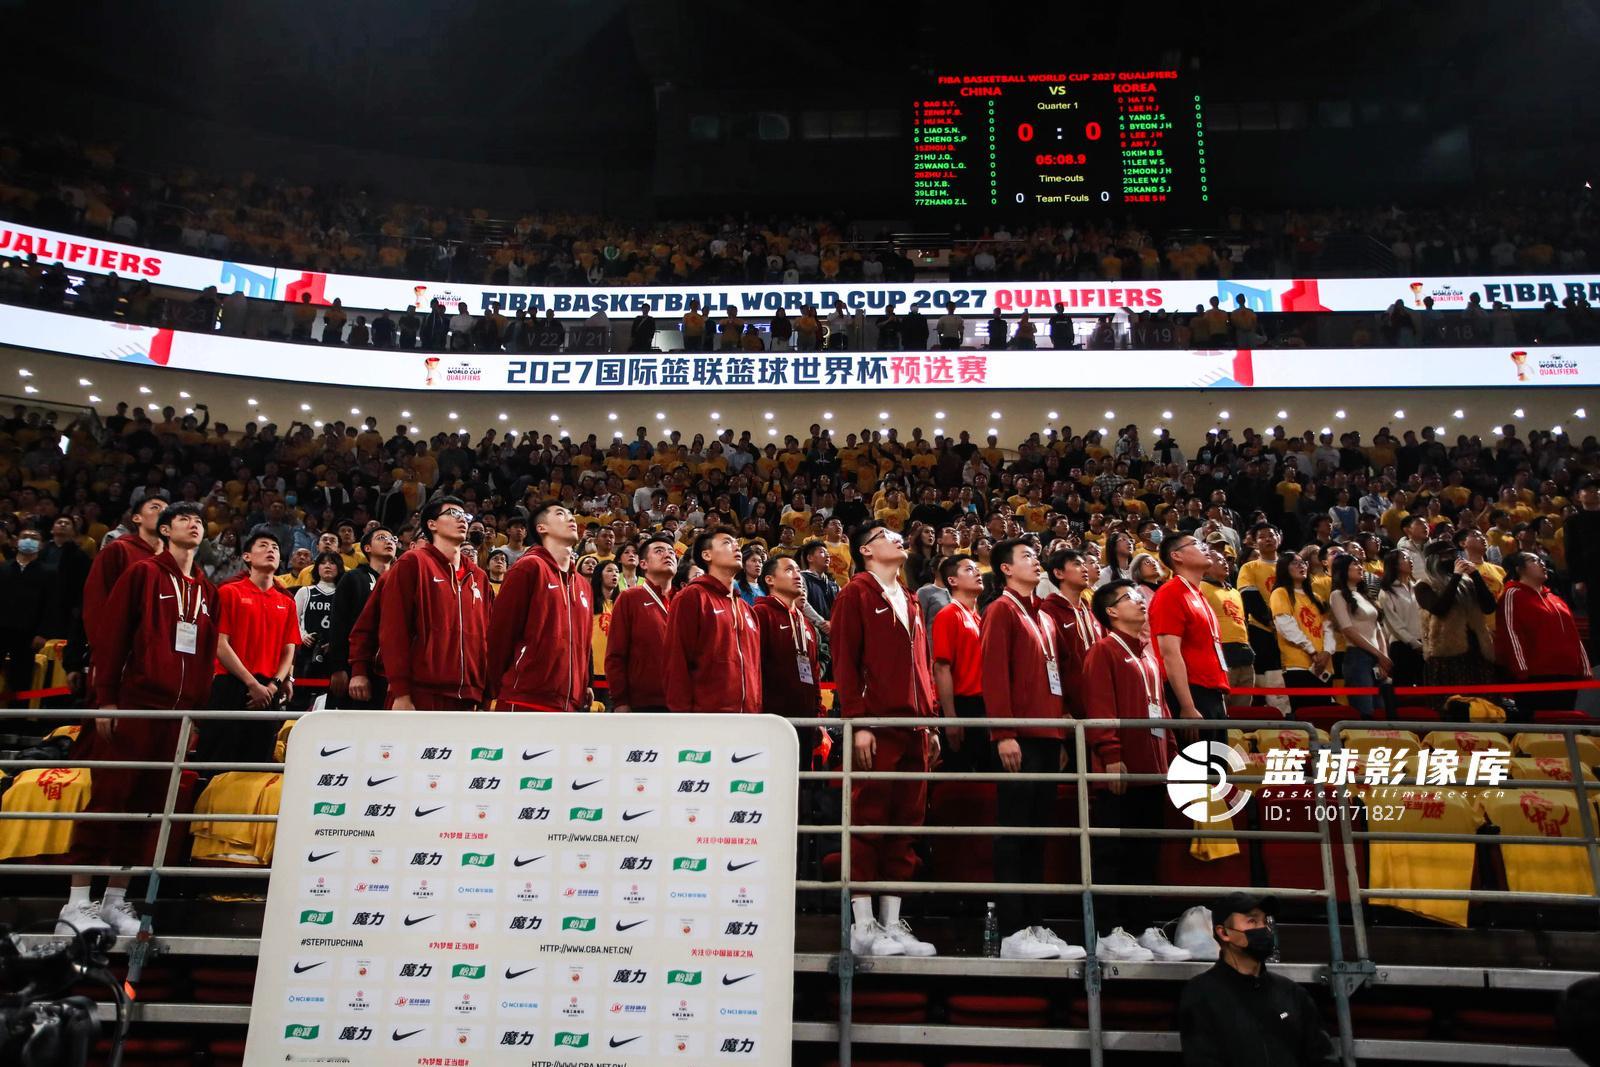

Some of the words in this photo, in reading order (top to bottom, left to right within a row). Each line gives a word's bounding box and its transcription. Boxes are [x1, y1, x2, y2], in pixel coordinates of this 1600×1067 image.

[938, 76, 961, 84] FIBA
[963, 75, 1026, 83] BASKETBALL
[1028, 74, 1067, 82] WORLD
[1118, 71, 1178, 80] QUALIFIERS
[960, 87, 1002, 97] CHINA
[1049, 86, 1066, 95] VS
[1113, 83, 1157, 93] KOREA
[1037, 102, 1071, 110] Quarter
[1018, 123, 1034, 142] 0
[1085, 122, 1101, 140] 0
[1035, 154, 1086, 165] 05:08.9
[1039, 174, 1084, 183] Time-outs
[1016, 193, 1024, 203] 0
[1036, 195, 1062, 203] Team
[1064, 194, 1089, 202] Fouls
[1101, 191, 1109, 201] 0
[1483, 283, 1558, 302] FIBA
[481, 292, 546, 311] FIBA
[553, 293, 730, 312] BASKETBALL
[741, 291, 839, 310] WORLD
[847, 290, 906, 309] CUP
[913, 290, 987, 308] 2027
[994, 288, 1163, 311] QUALIFIERS
[507, 355, 988, 386] 2027国际篮联篮球世界杯预选赛
[310, 601, 331, 611] KOR
[321, 615, 330, 629] 6
[421, 747, 452, 760] 魔力
[626, 749, 659, 763] 魔力
[317, 774, 349, 787] 魔力
[468, 776, 500, 790] 魔力
[677, 779, 710, 793] 魔力
[364, 803, 396, 817] 魔力
[518, 806, 550, 820] 魔力
[729, 810, 762, 824] 魔力
[314, 829, 375, 838] #STEPITUPCHINA
[547, 833, 639, 844] HTTP://WWW.CBA.NET.CN/
[410, 852, 442, 865] 魔力
[620, 856, 653, 870] 魔力
[352, 912, 384, 926] 魔力
[509, 916, 542, 930] 魔力
[724, 921, 759, 935] 魔力
[300, 938, 364, 948] #STEPITUPCHINA
[540, 944, 633, 956] HTTP://WWW.CBA.NET.CN/
[399, 963, 432, 977] 魔力
[613, 969, 647, 984] 魔力
[339, 1026, 373, 1041] 魔力
[500, 1031, 534, 1046] 魔力
[720, 1038, 755, 1053] 魔力
